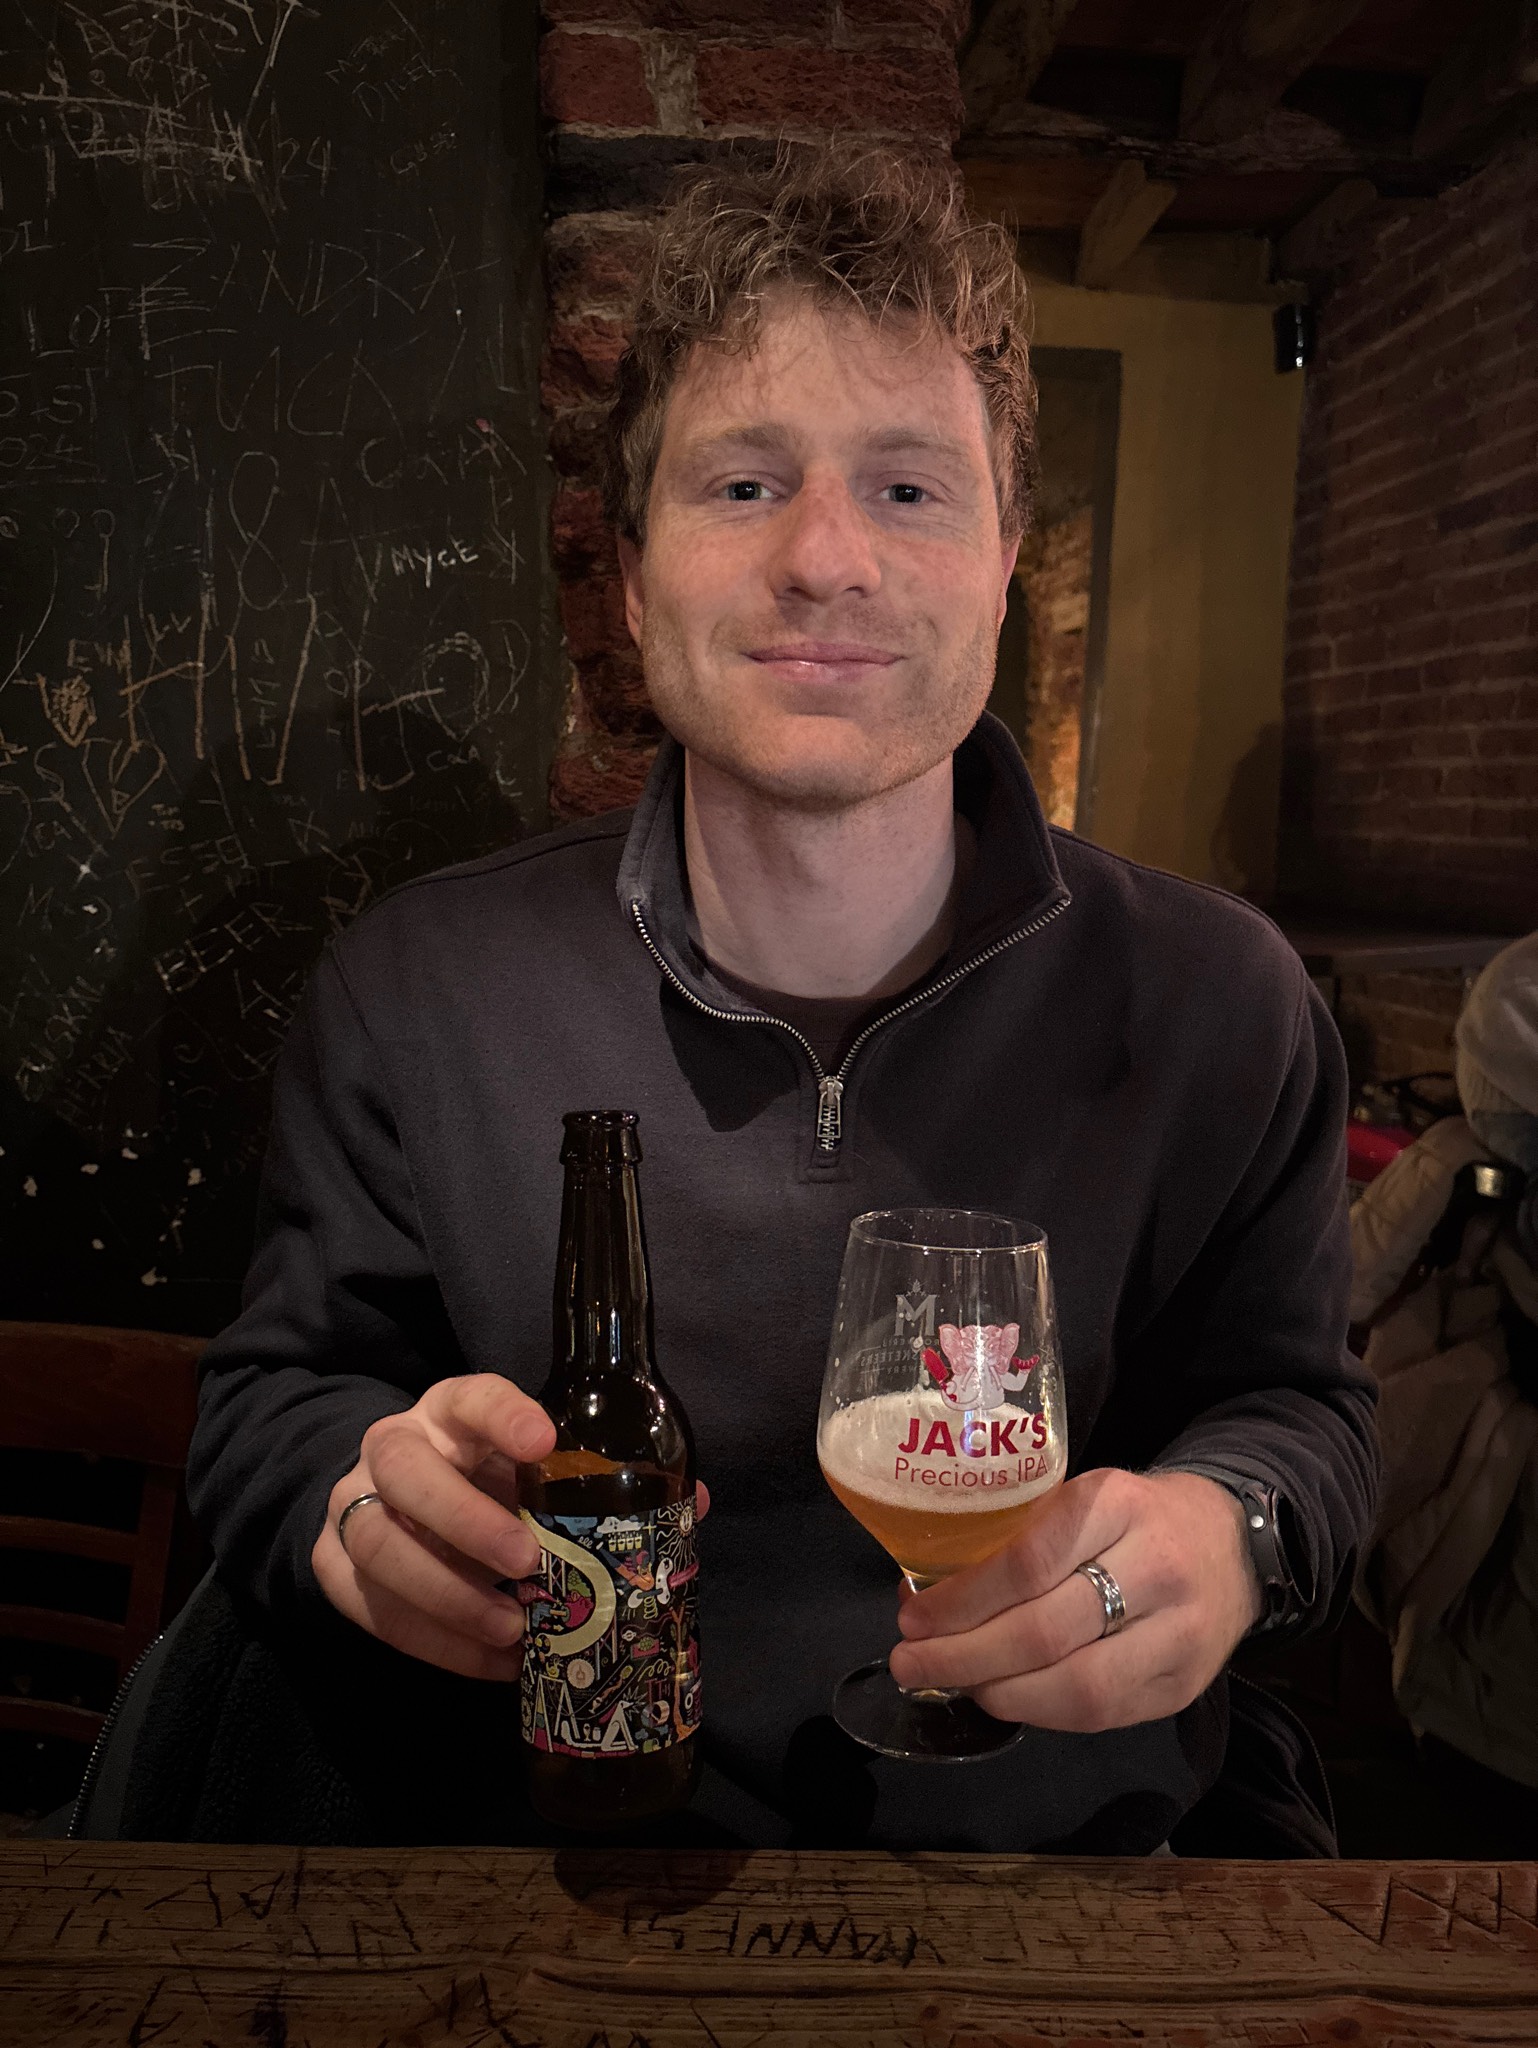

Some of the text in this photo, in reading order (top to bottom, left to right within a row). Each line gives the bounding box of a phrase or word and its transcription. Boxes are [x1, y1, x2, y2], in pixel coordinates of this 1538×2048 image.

[898, 1412, 1048, 1459] JACK'S
[894, 1454, 1049, 1488] Precious IPA
